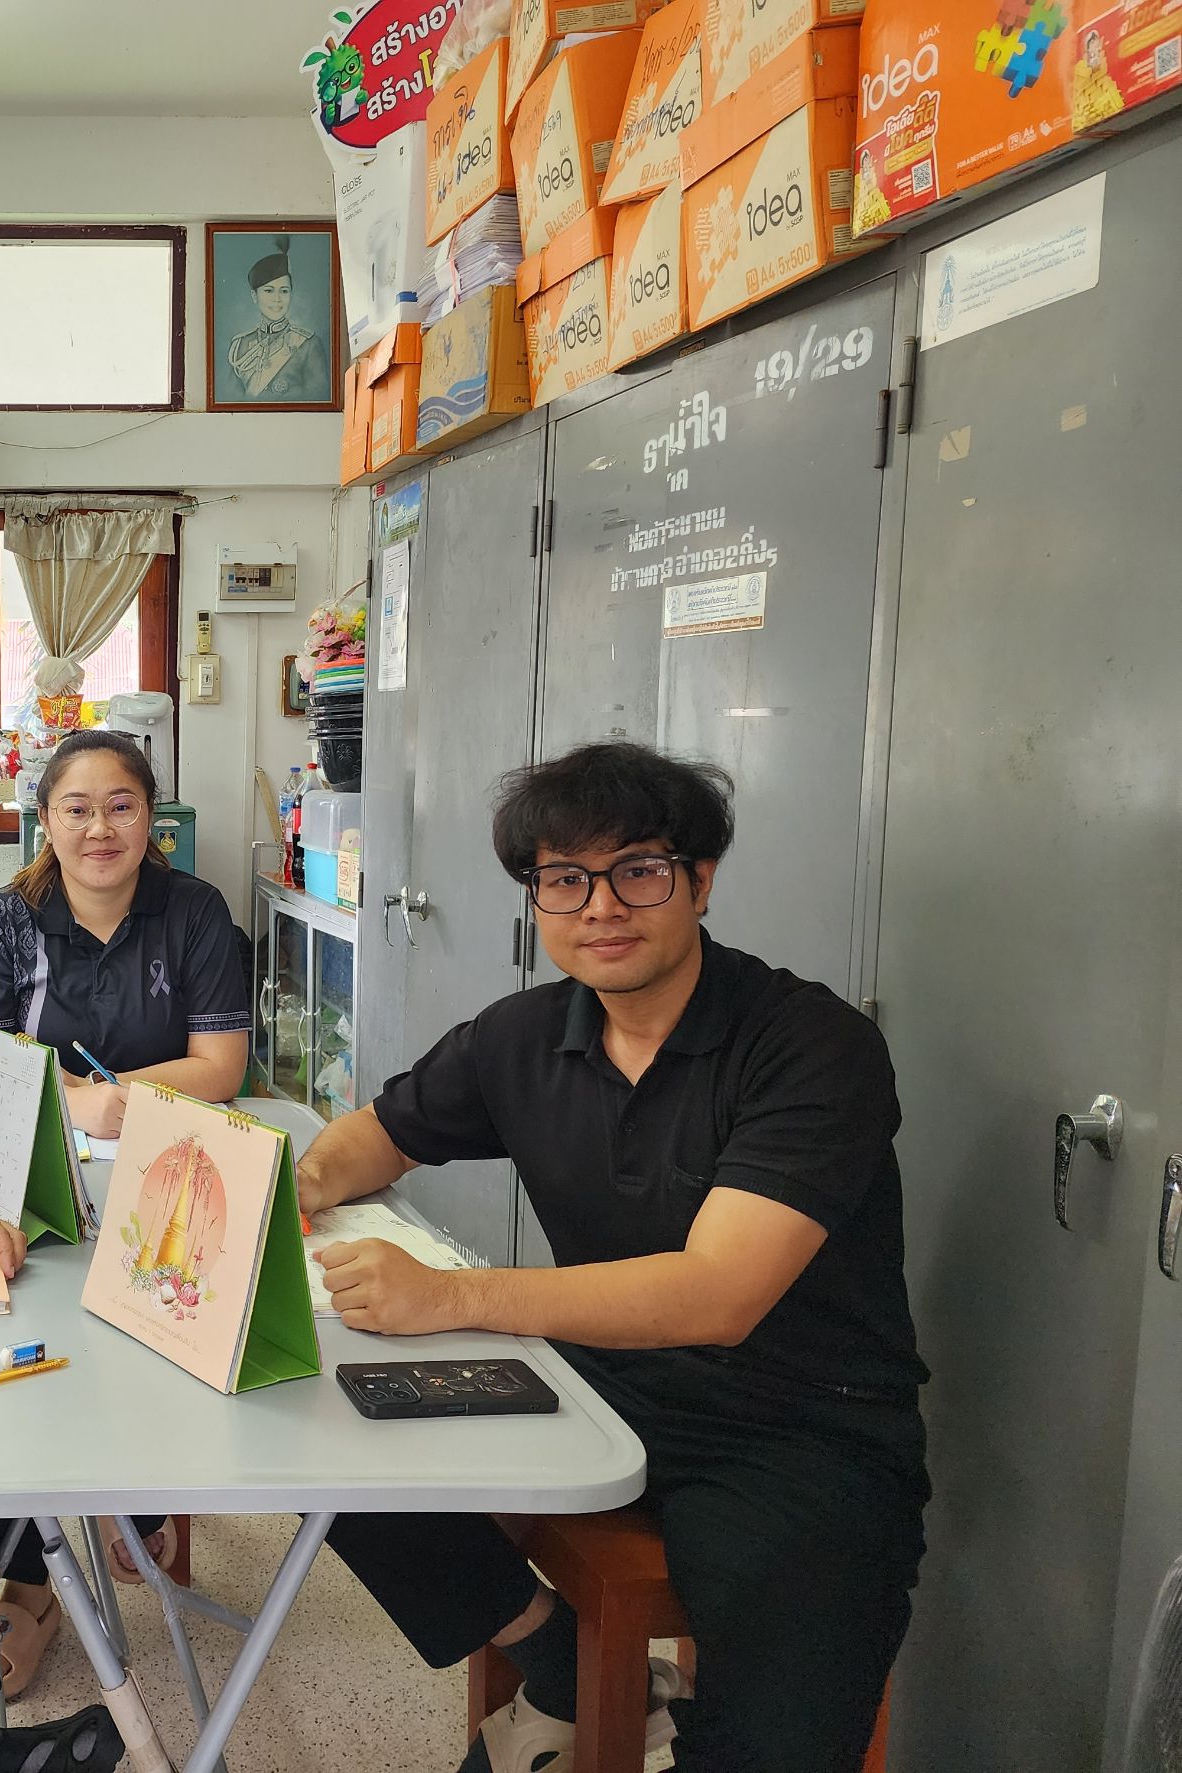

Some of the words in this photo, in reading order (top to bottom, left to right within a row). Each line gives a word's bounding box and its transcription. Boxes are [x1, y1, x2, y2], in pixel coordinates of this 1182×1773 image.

[918, 22, 941, 45] MAX
[862, 43, 939, 118] idea
[654, 100, 695, 140] idea
[456, 136, 492, 185] idea
[538, 158, 574, 202] idea
[786, 168, 801, 182] MAX
[746, 184, 803, 241] idea
[656, 248, 670, 260] MAX
[761, 264, 775, 286] A4
[778, 243, 811, 276] 5x500
[629, 263, 669, 308] idea
[561, 314, 602, 352] idea
[754, 324, 874, 401] 19/29
